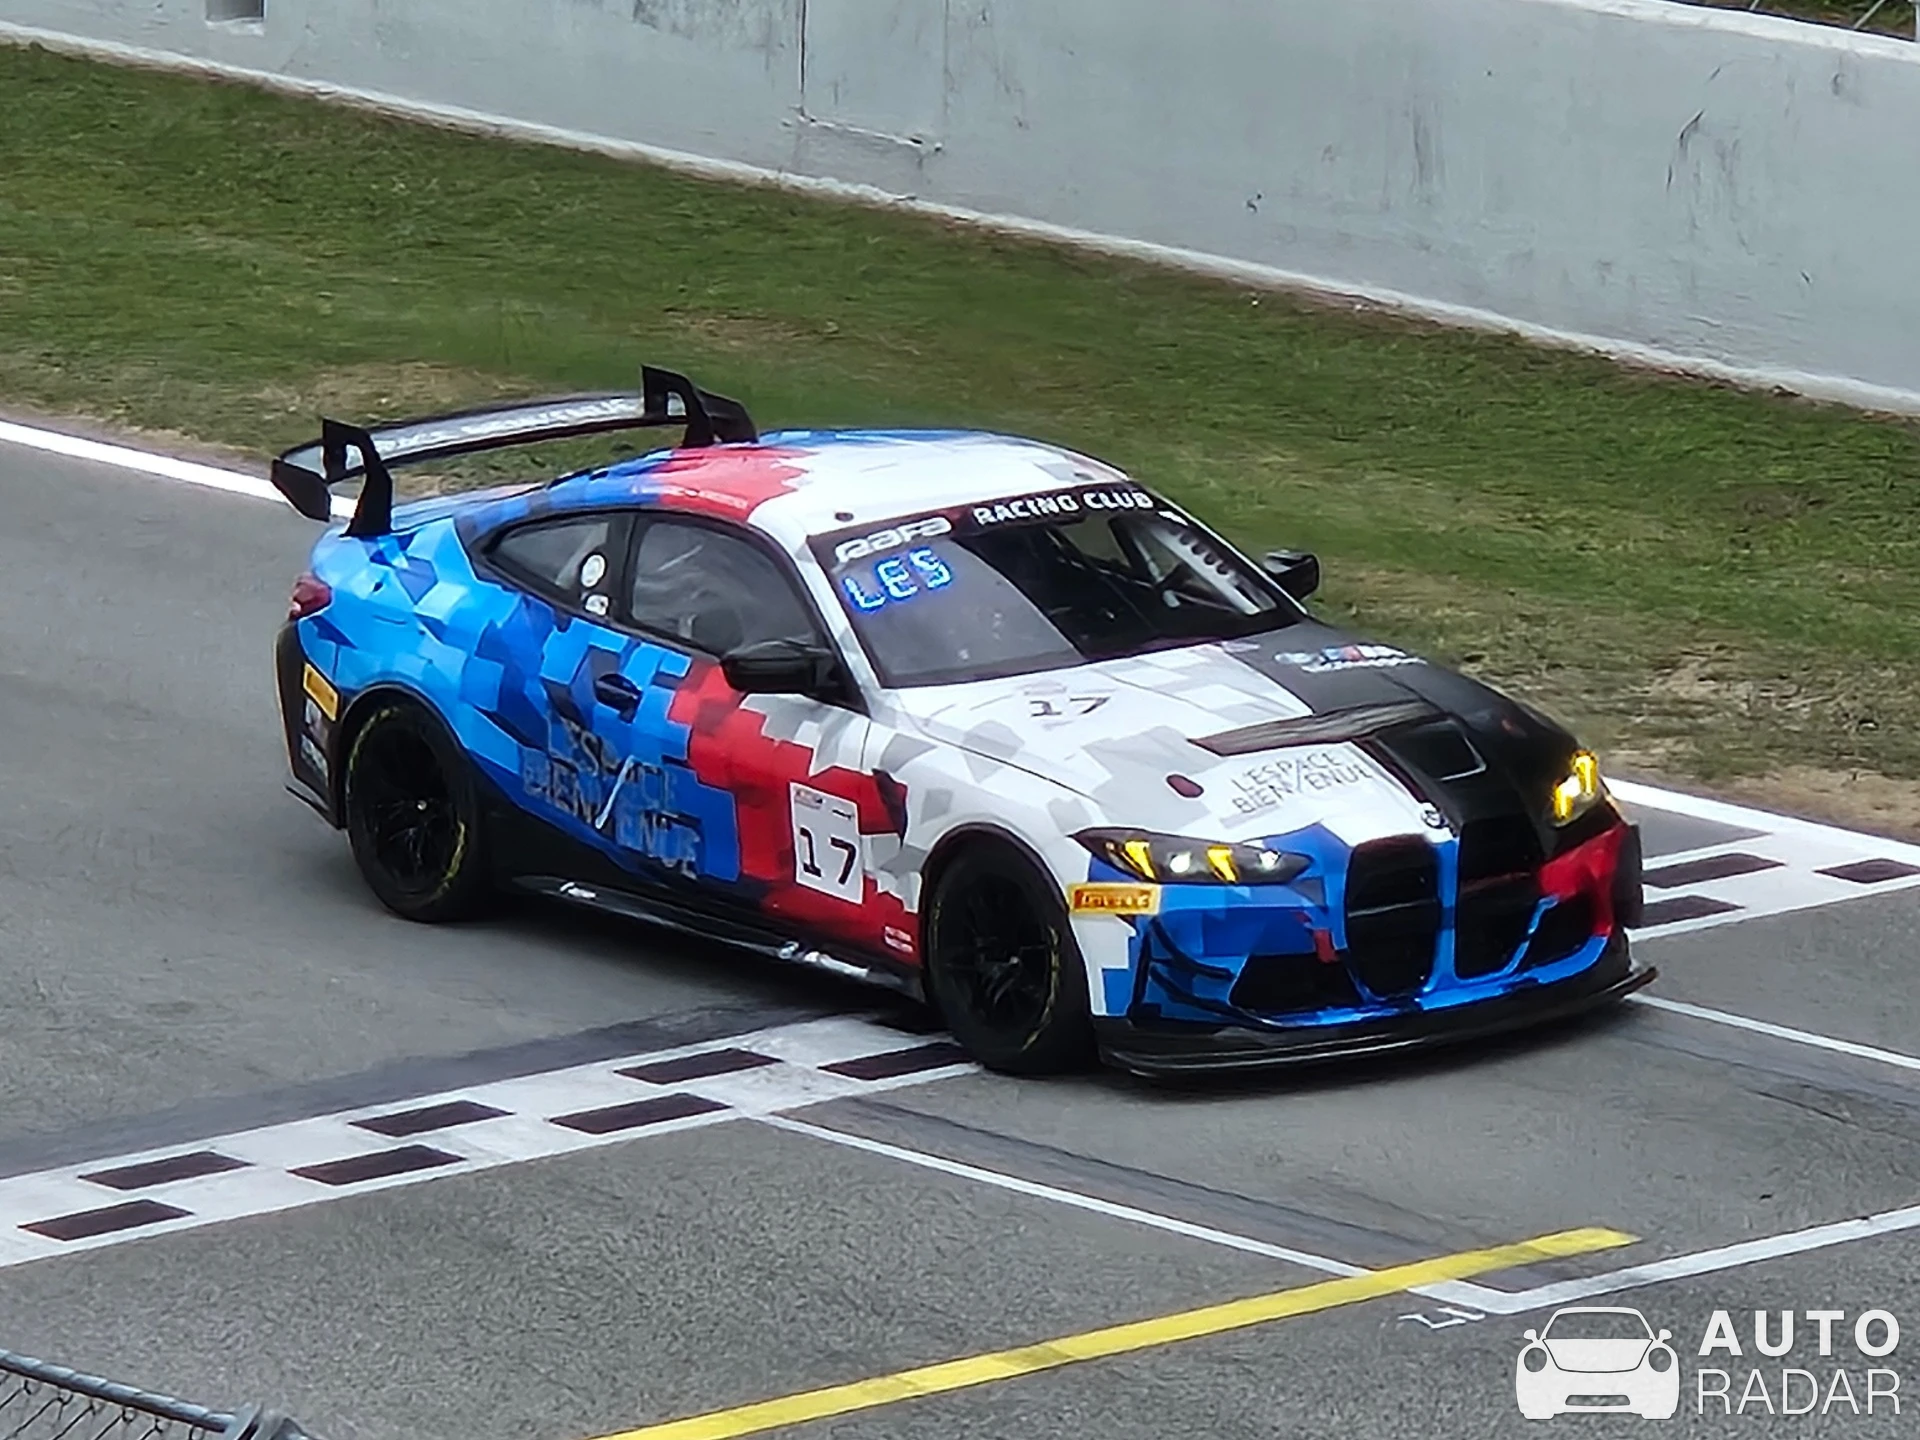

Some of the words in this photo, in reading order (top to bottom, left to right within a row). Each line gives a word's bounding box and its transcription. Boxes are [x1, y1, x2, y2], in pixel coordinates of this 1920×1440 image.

[973, 494, 1080, 526] RACING
[1083, 492, 1154, 510] CLUB
[1029, 697, 1111, 717] 17
[800, 826, 857, 885] 17
